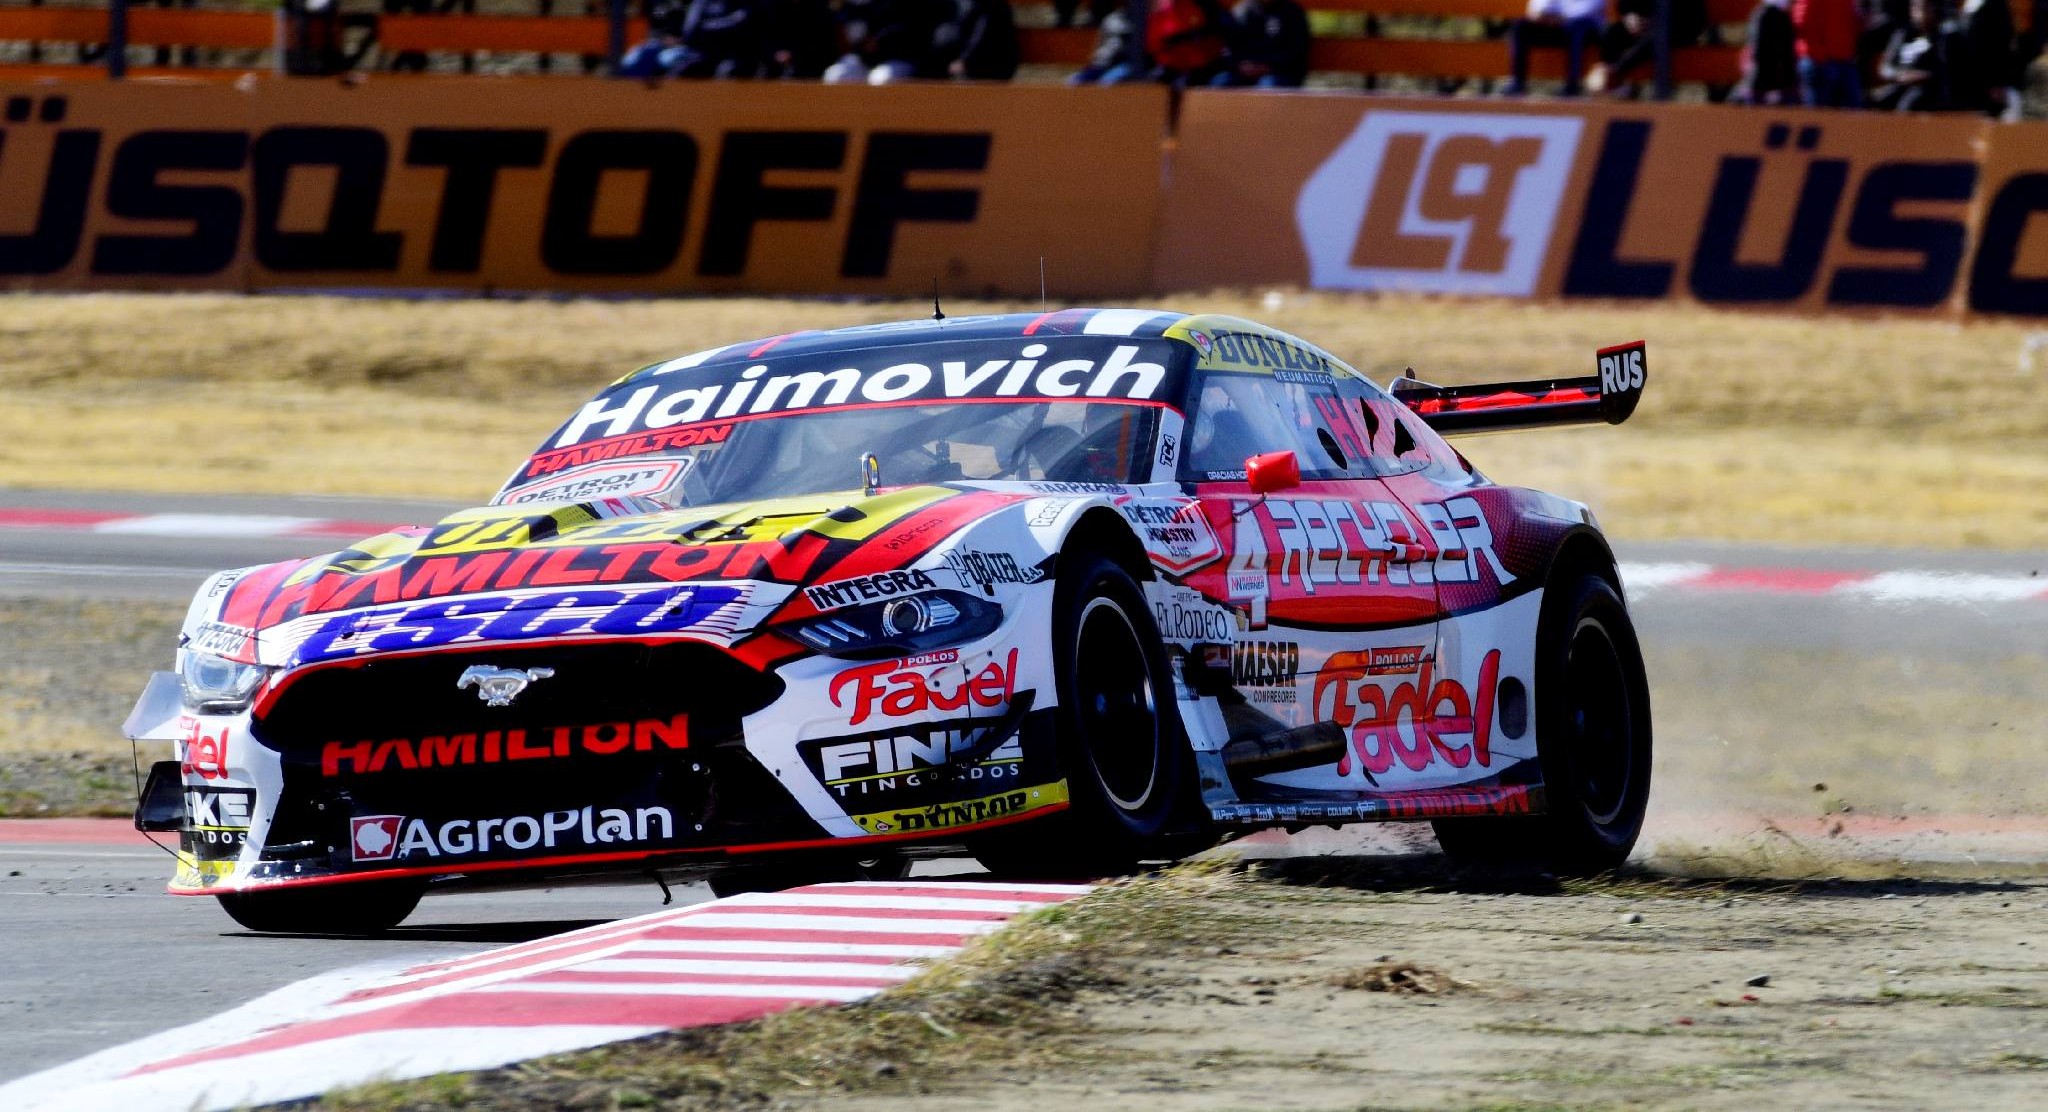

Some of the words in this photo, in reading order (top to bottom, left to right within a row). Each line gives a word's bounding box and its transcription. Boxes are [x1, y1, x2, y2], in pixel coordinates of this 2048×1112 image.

[1600, 351, 1644, 394] RUS
[553, 344, 1167, 449] Haimovich
[527, 425, 732, 477] HAMILTON
[1160, 433, 1176, 467] TC4
[516, 470, 656, 504] DETROIT
[1123, 505, 1196, 524] DETROIT
[260, 531, 830, 627] HAMILTON
[807, 570, 936, 609] INTEGRA
[907, 651, 955, 666] POLLOS
[1233, 641, 1299, 688] KAESER
[321, 713, 689, 777] HAMILTON
[900, 792, 1027, 831] DUNLOP
